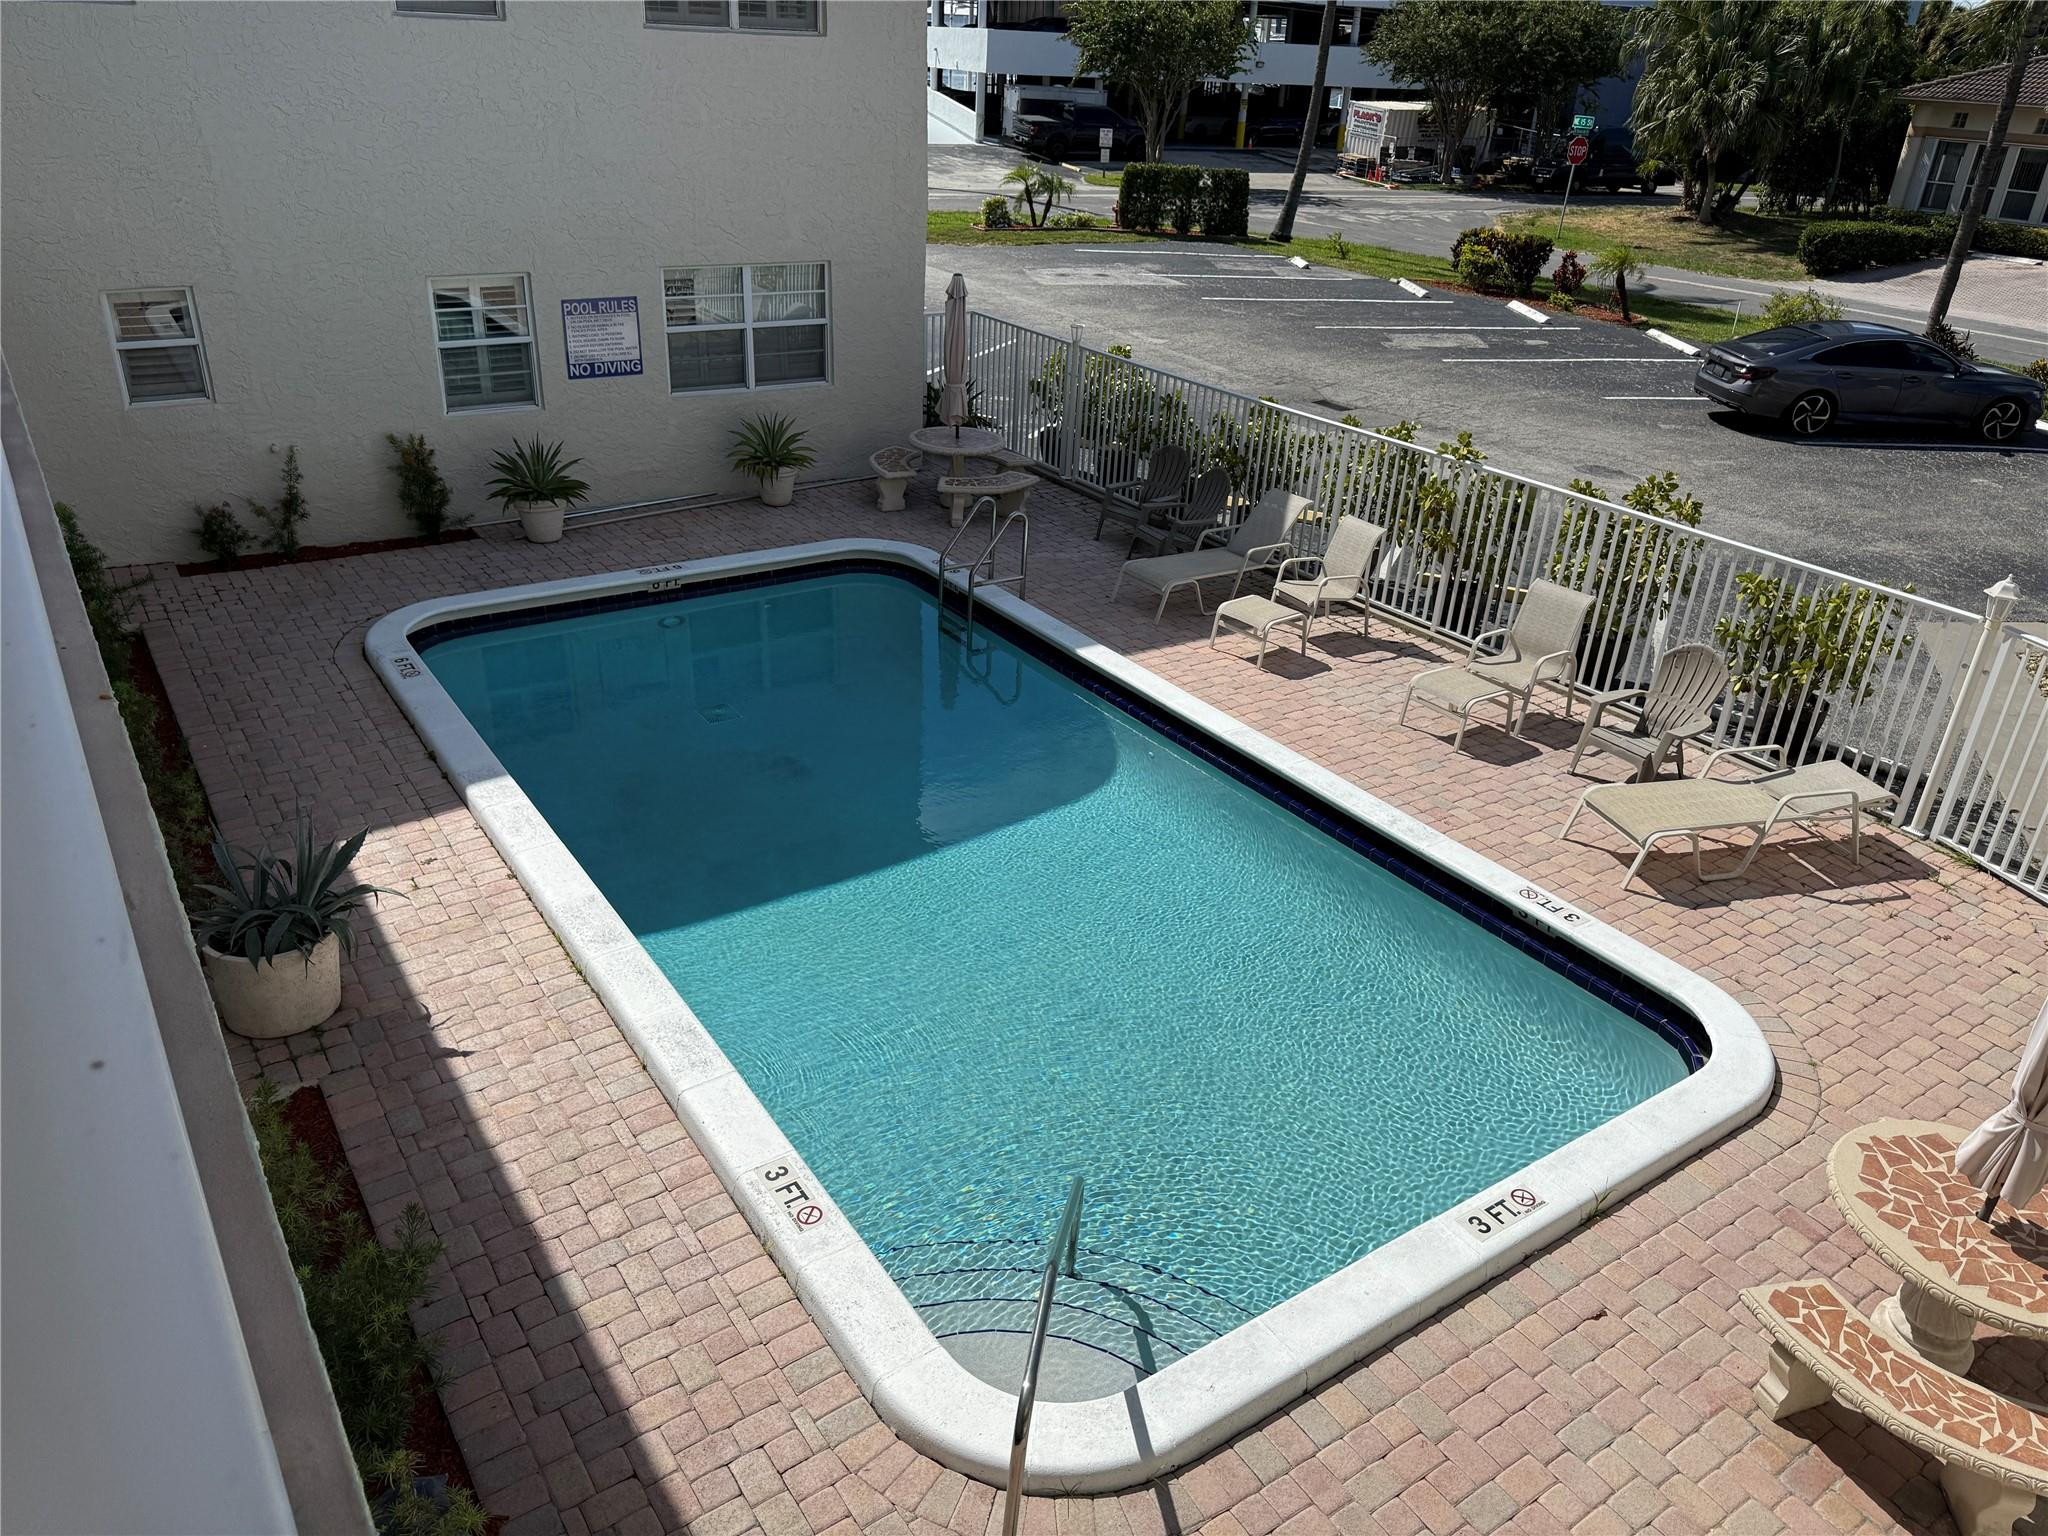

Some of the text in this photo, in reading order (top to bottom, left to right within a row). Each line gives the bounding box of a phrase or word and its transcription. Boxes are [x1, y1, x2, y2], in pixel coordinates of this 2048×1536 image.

[1570, 146, 1587, 156] STOP
[563, 300, 636, 315] POOL RULES
[570, 360, 641, 376] NO DIVING
[765, 1166, 809, 1208] 3 FT.
[1468, 1199, 1521, 1233] 3 FT.
